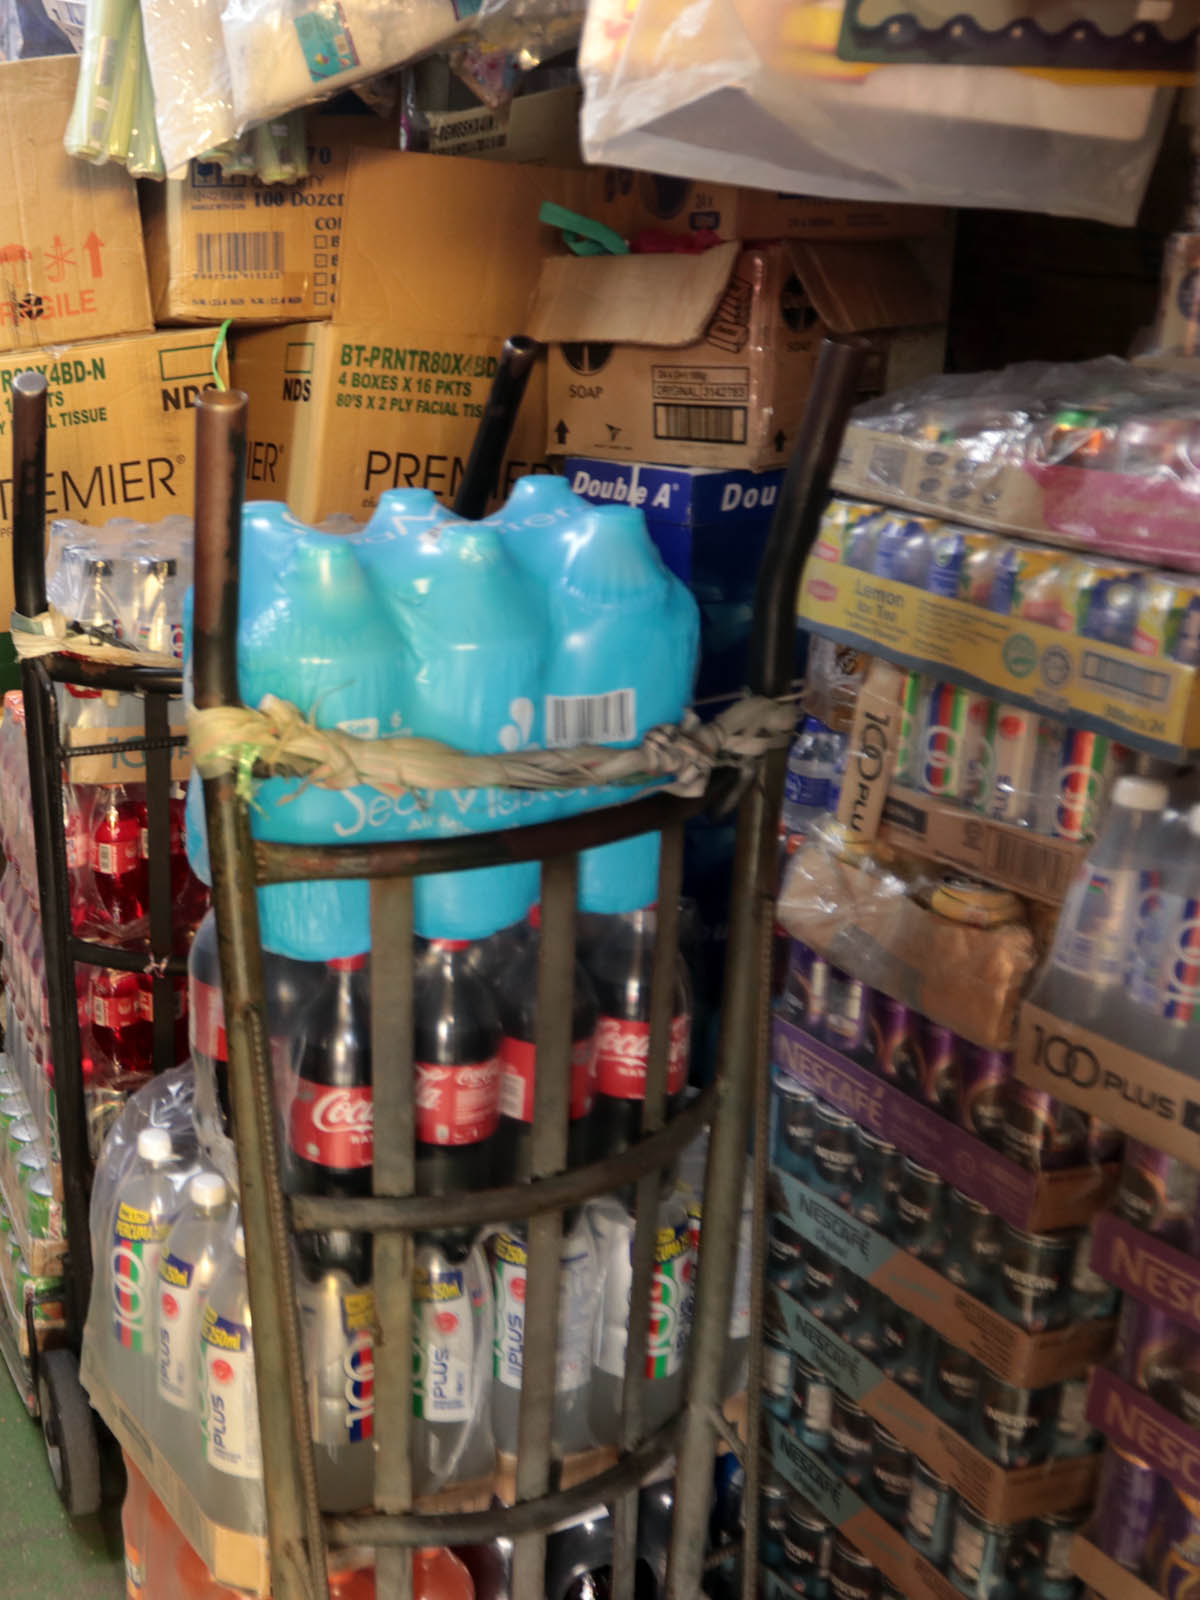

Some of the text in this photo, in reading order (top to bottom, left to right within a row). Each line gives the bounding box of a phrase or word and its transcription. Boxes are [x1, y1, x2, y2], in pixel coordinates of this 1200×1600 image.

[283, 377, 312, 403] NDS
[338, 371, 473, 398] 4 BOXES X 16 PKTS
[568, 383, 604, 399] SOAP
[60, 407, 107, 427] TISSUE
[366, 396, 376, 410] X
[378, 397, 387, 412] 2
[390, 397, 413, 414] PLY
[416, 400, 459, 417] FACIAL
[572, 470, 671, 509] Double A
[721, 484, 778, 511] Dou
[855, 580, 905, 607] Lemon
[851, 782, 872, 833] PLU
[1034, 1025, 1177, 1121] 100 PLUS
